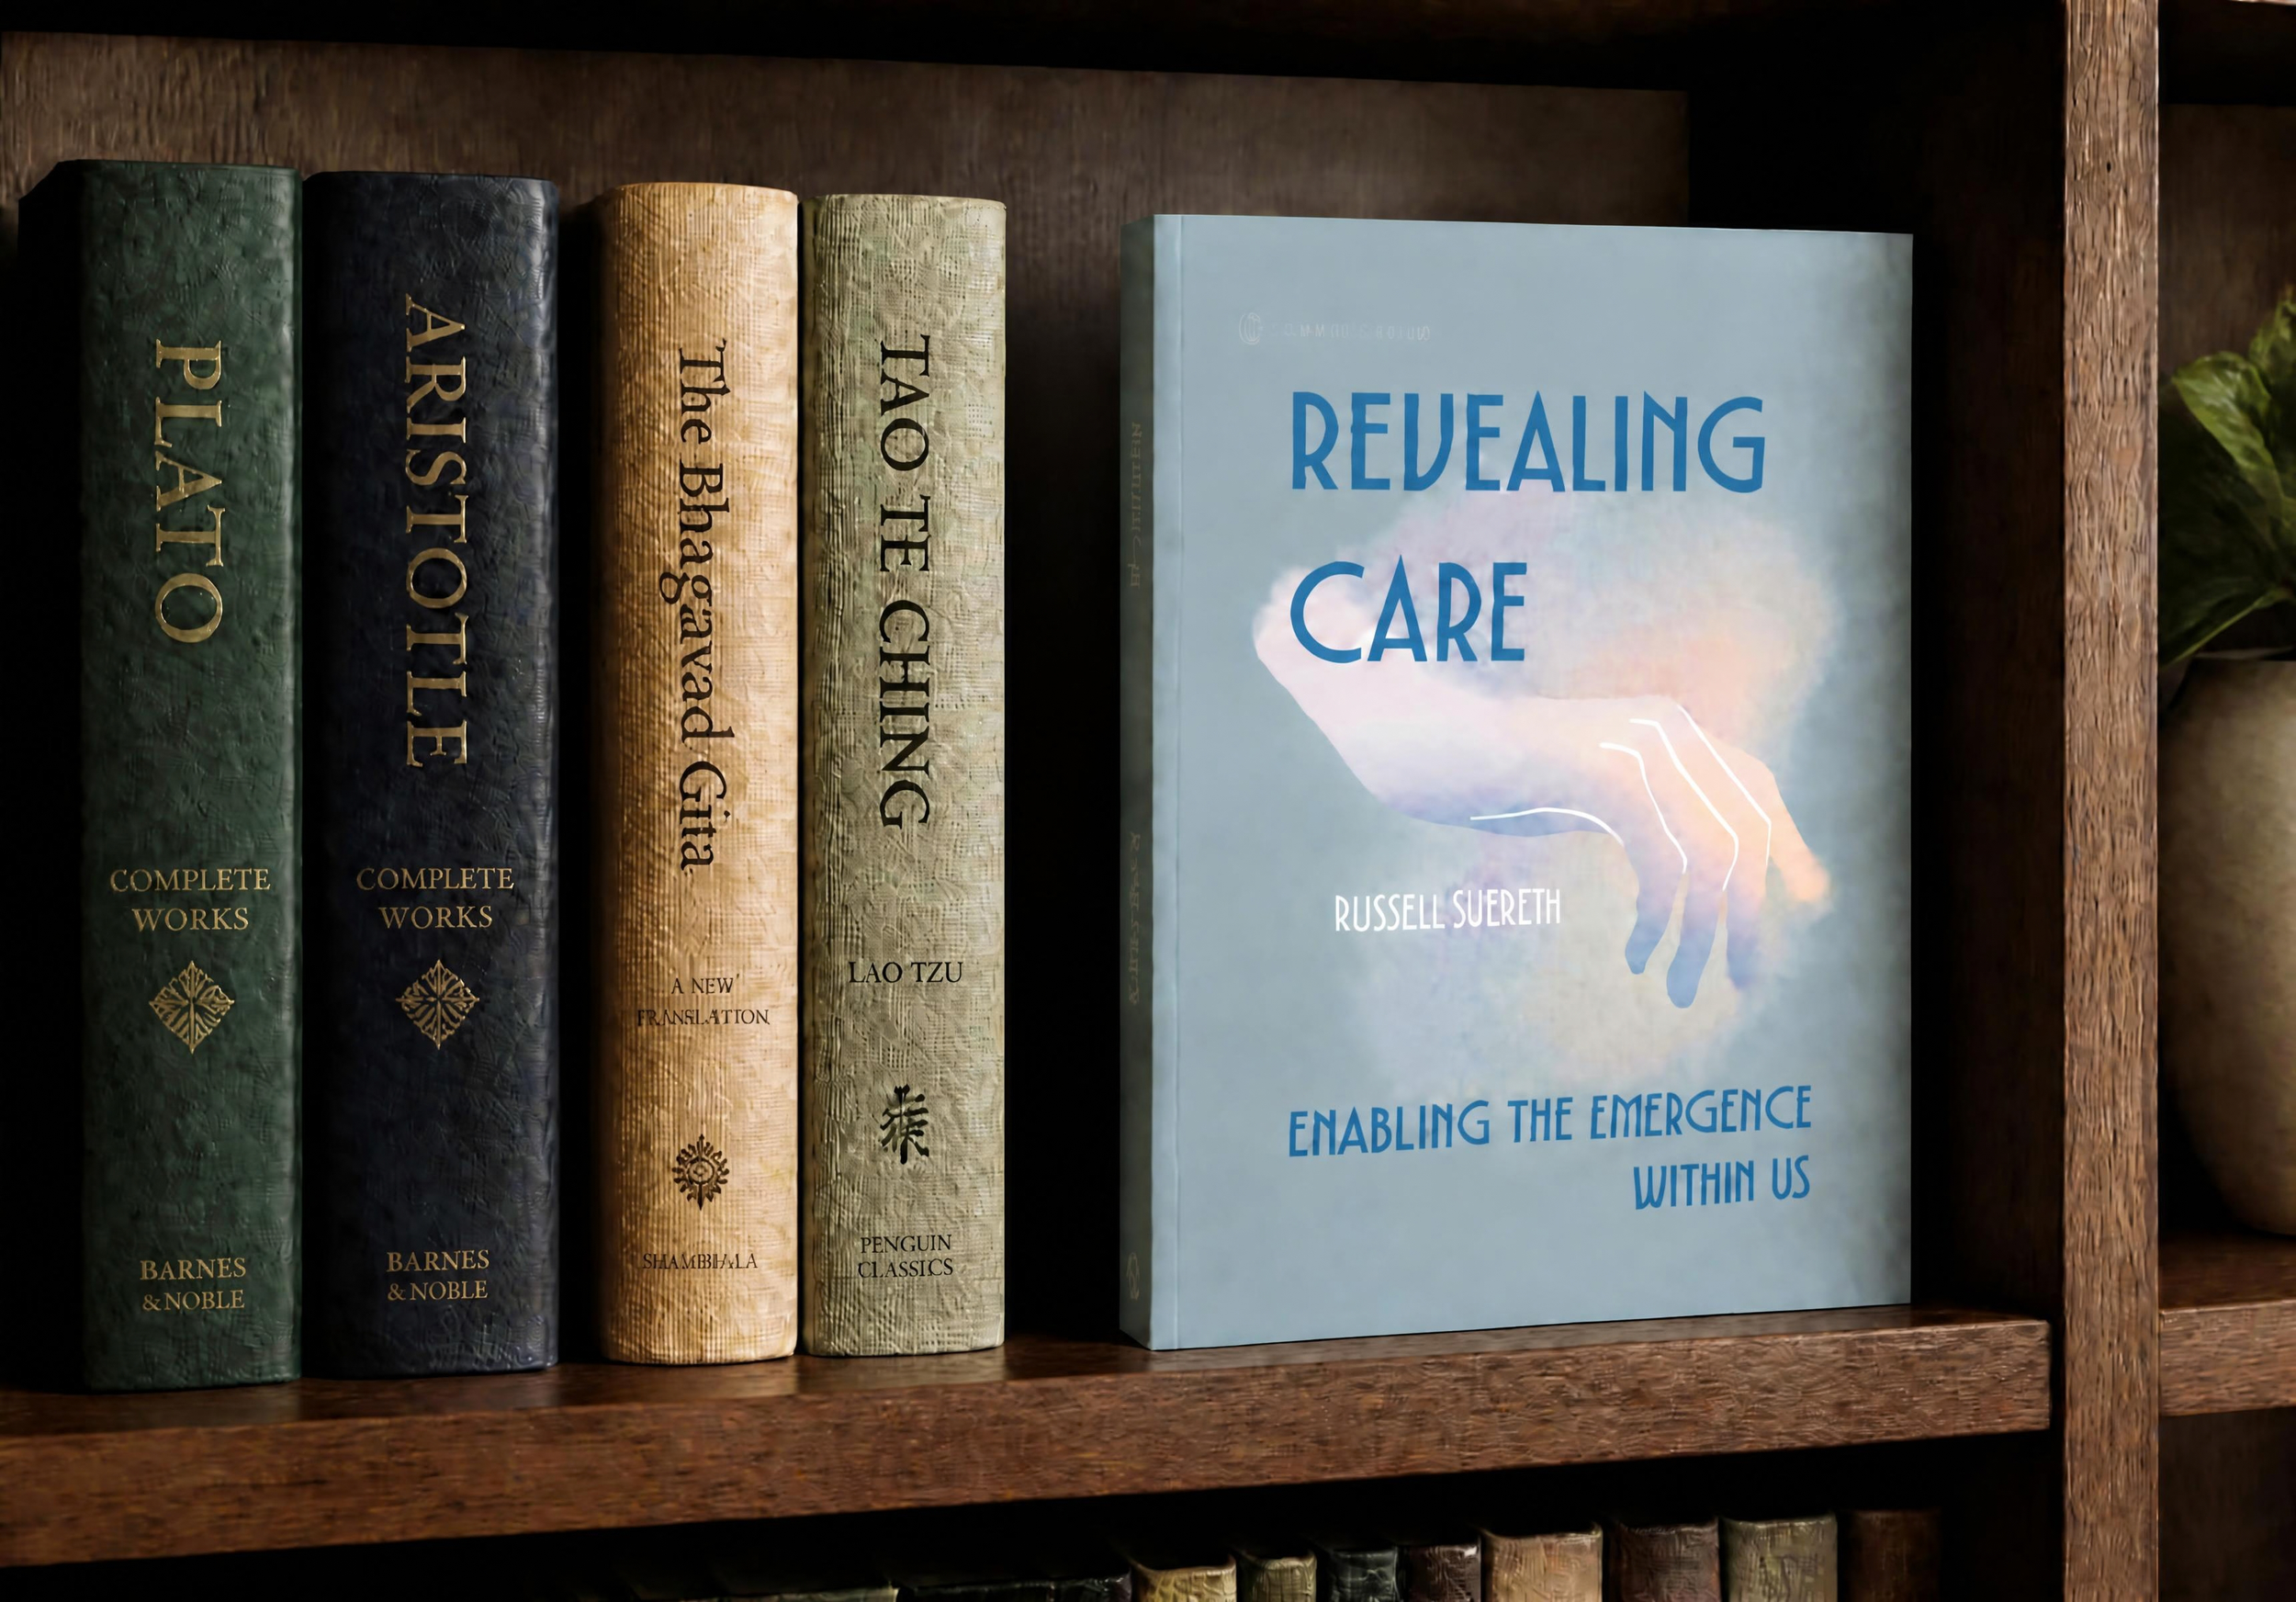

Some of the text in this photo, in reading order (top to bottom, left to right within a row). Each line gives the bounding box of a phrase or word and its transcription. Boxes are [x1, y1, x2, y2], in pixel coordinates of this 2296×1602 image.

[1291, 389, 1765, 493] REVEALING
[153, 339, 224, 645] PLATO
[402, 292, 469, 768] ARISTOTLE
[879, 334, 930, 830] TAO TE CHING
[658, 338, 736, 873] The Bhagavad Gita
[1289, 554, 1527, 663] CARE
[109, 867, 272, 892] COMPLETE
[355, 866, 515, 891] COMPLETE
[131, 906, 250, 931] WORKS
[378, 904, 493, 930] WORKS
[1334, 893, 1446, 931] RUSSELL
[849, 961, 964, 984] LAO TZU
[670, 977, 734, 995] A NEW
[1289, 1085, 1812, 1157] ENABLING THE EMERGENCE
[1633, 1155, 1811, 1211] WITHIN US
[860, 1235, 952, 1254] PENGUIN
[140, 1258, 247, 1280] BARNES
[386, 1249, 490, 1272] BARNES
[858, 1258, 954, 1280] CLASSICS
